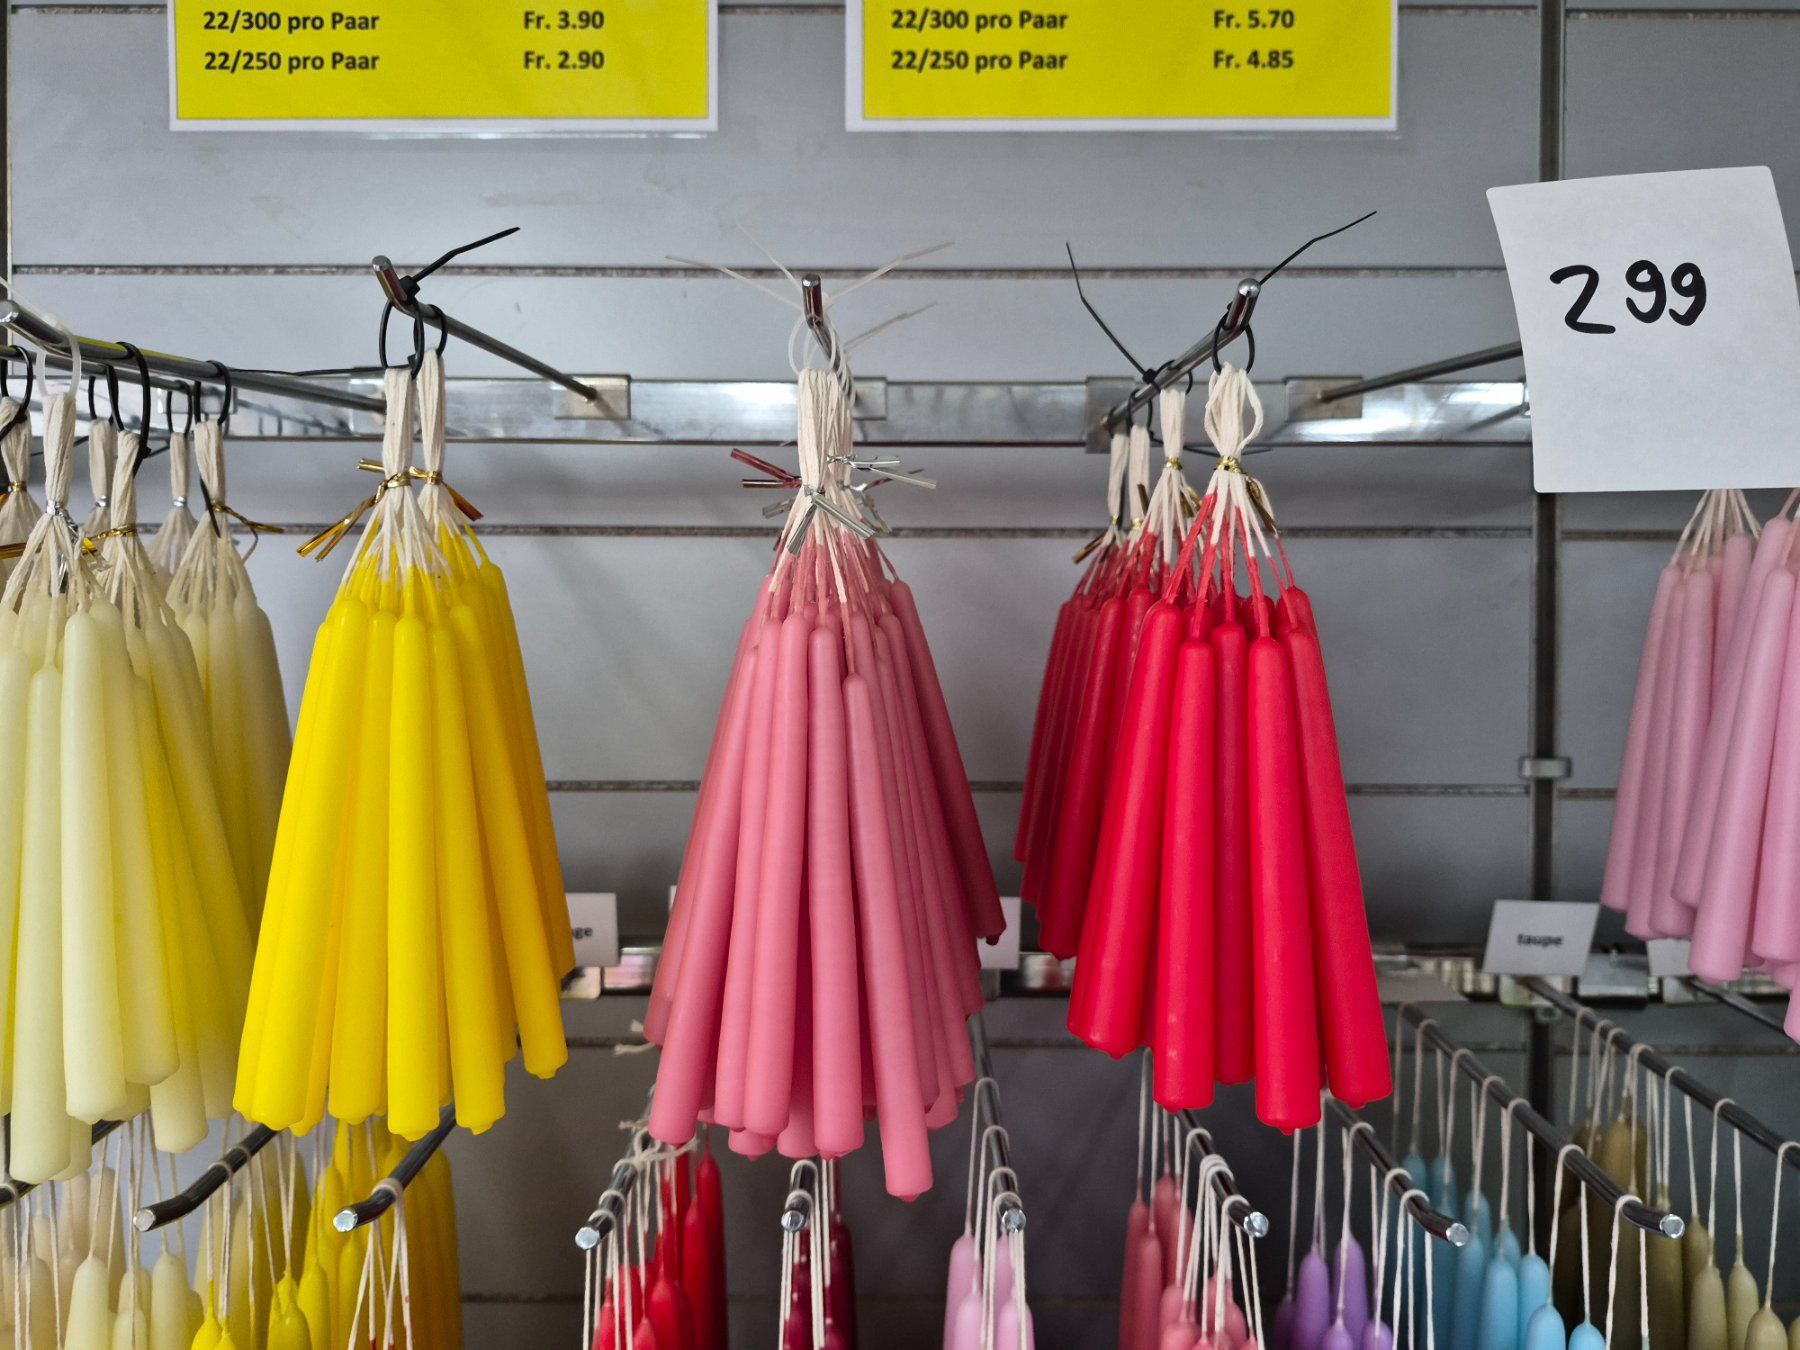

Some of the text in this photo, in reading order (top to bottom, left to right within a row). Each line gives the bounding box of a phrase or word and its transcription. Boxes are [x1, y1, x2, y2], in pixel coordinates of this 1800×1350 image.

[203, 9, 605, 35] 22/300 pro Paar Fr. 3.90
[891, 7, 1296, 34] 22/300 pro Paar Fr. 5.70
[204, 49, 605, 75] 22/250 pro Paar Fr. 2.90
[891, 48, 1295, 75] 22/250 pro Paar Fr. 4.85
[1517, 933, 1564, 949] taupe
